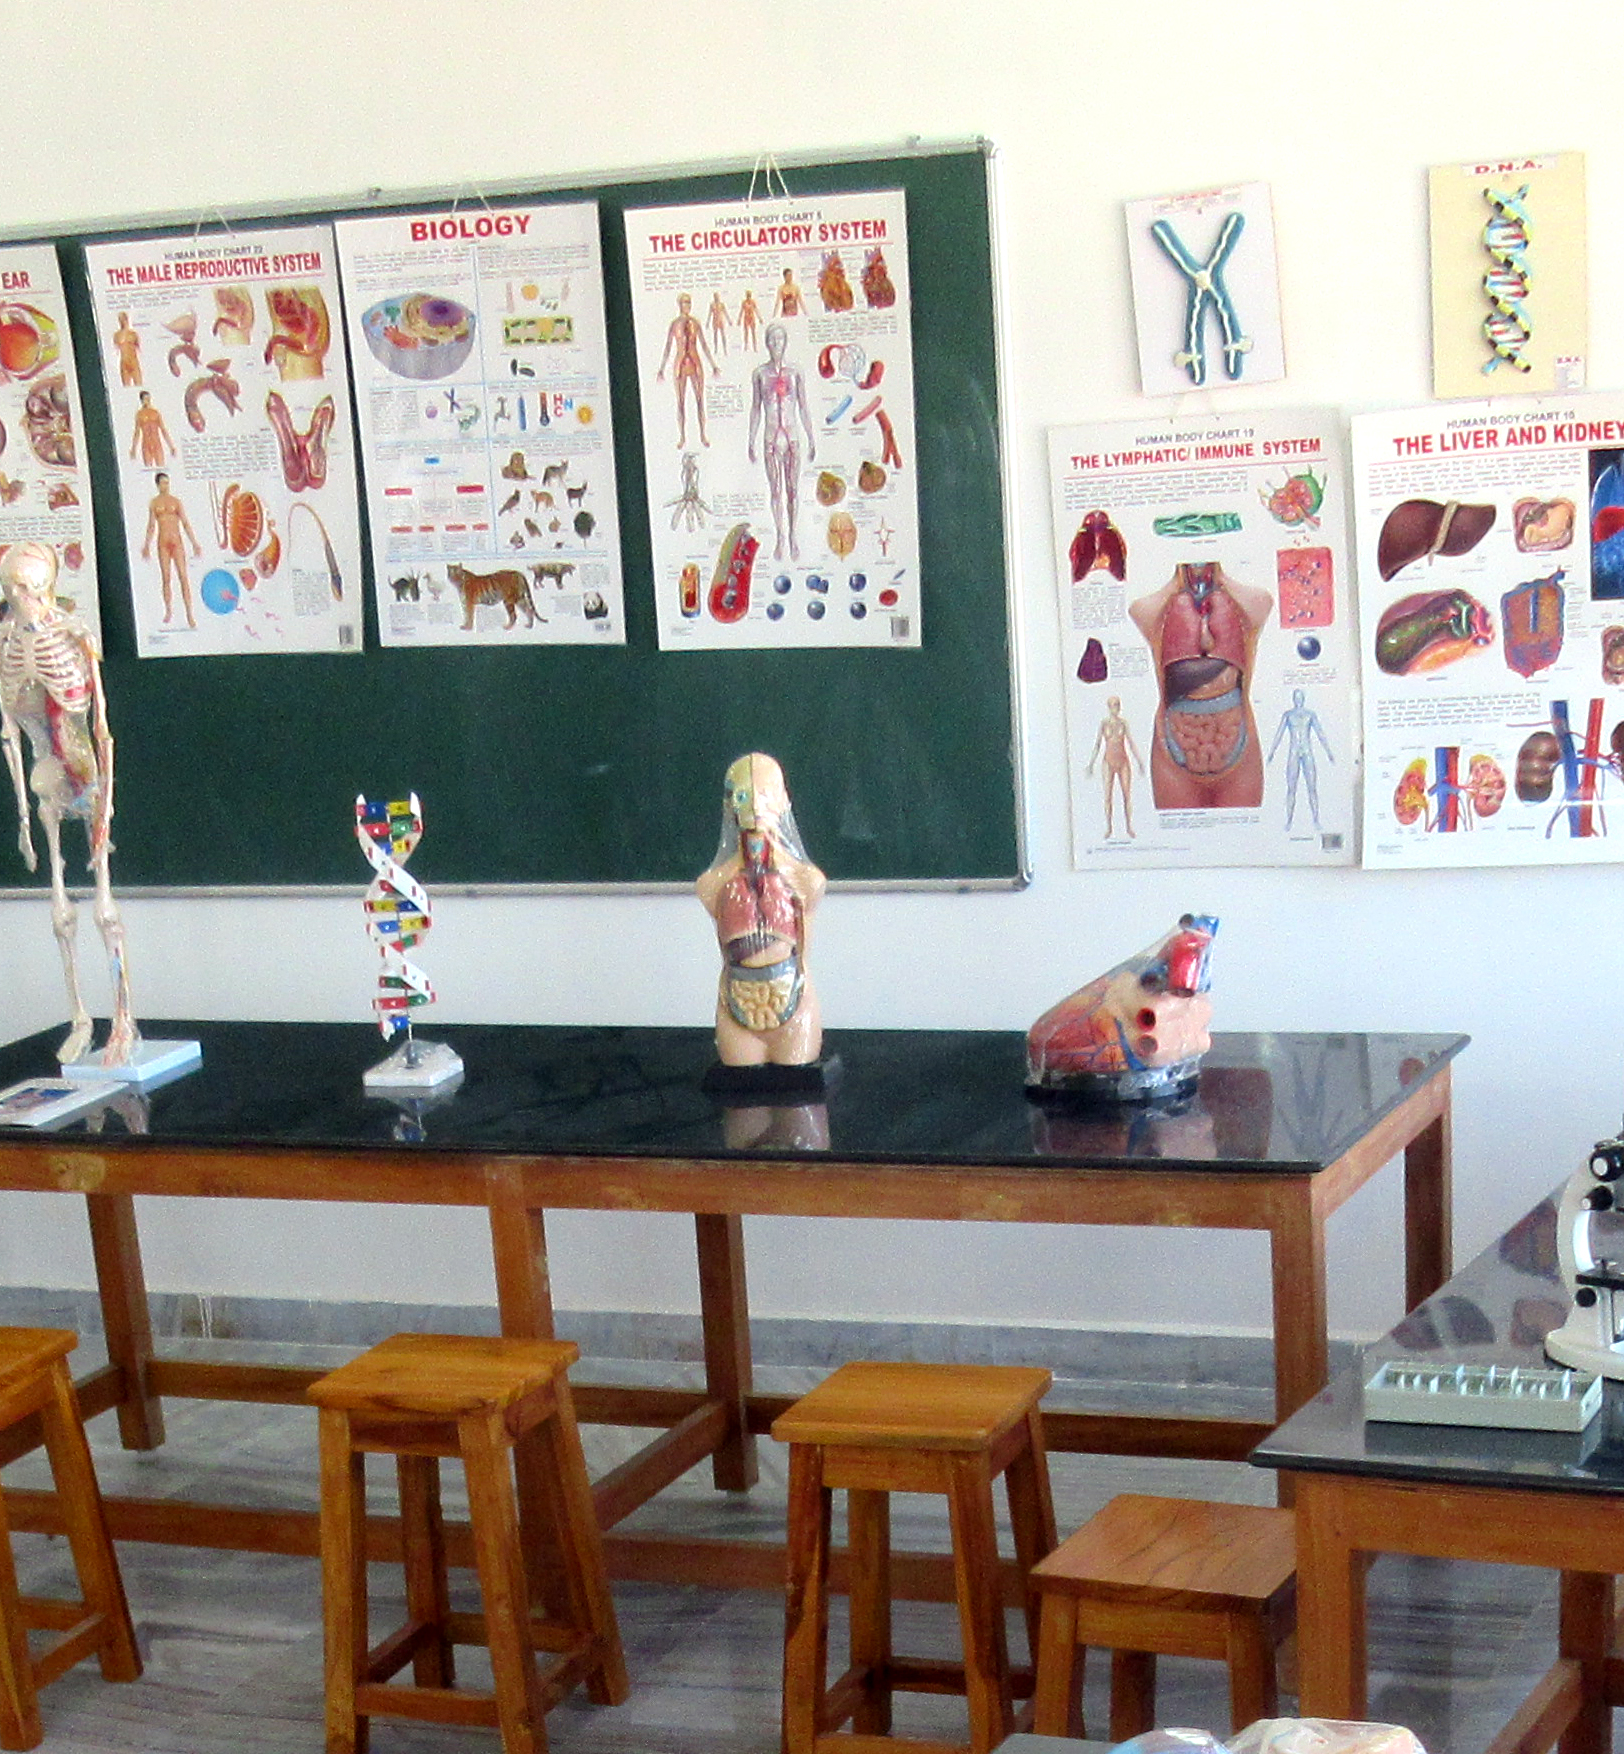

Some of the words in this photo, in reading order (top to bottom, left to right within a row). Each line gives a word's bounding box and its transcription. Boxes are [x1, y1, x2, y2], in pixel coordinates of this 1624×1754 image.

[410, 214, 530, 241] BIOLOGY
[649, 233, 685, 253] THE
[691, 224, 812, 251] CIRCULATORY
[818, 219, 887, 242] SYSTEM
[2, 270, 31, 289] EAR
[106, 266, 134, 286] THE
[137, 263, 172, 283] MALE
[175, 256, 270, 280] REPRODUCTIVE
[272, 252, 321, 273] SYSTEM
[1446, 417, 1487, 430] HUMAN
[1490, 415, 1520, 426] BODY
[1523, 412, 1561, 424] CHART
[1135, 434, 1173, 446] HUMAN
[1175, 432, 1203, 443] BODY
[1206, 430, 1241, 441] CHART
[1393, 435, 1433, 457] THE
[1440, 429, 1499, 453] LIVER
[1505, 425, 1547, 447] AND
[1071, 454, 1100, 469] THE
[1105, 447, 1190, 468] LYMPHATIC/
[1195, 443, 1254, 461] IMMUNE
[1262, 438, 1321, 456] SYSTEM
